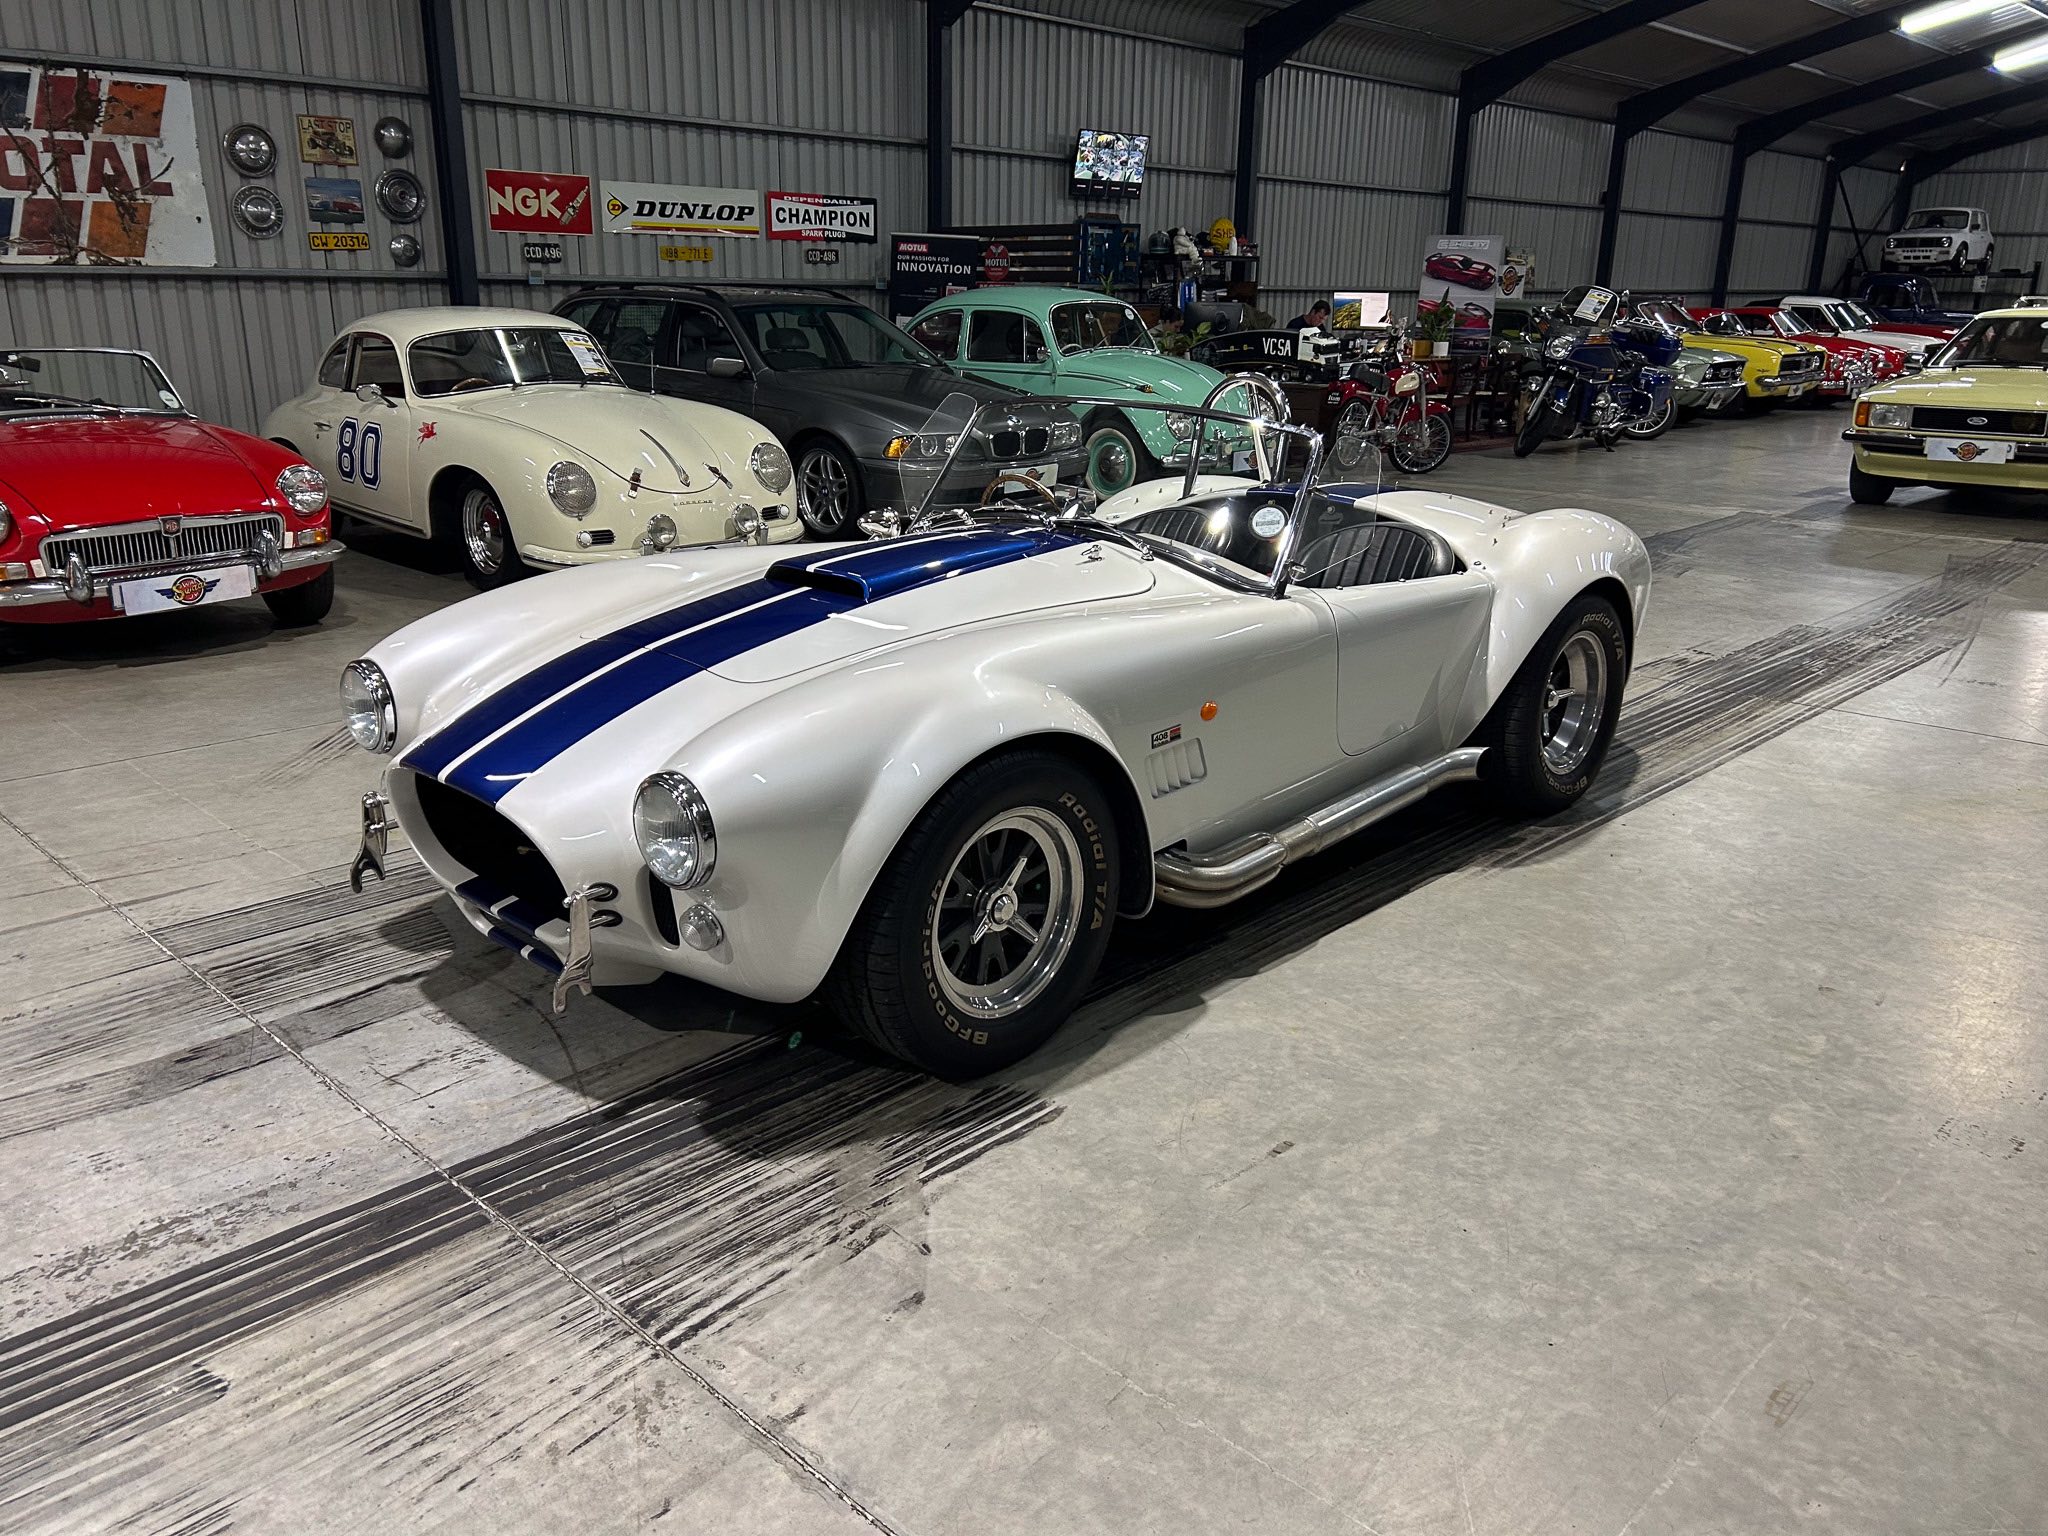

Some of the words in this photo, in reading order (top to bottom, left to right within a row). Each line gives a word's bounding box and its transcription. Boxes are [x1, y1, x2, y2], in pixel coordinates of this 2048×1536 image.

[301, 119, 327, 131] LAST
[327, 121, 352, 134] STOP
[489, 186, 562, 219] NGK
[783, 195, 861, 206] DEPENDABLE
[633, 200, 755, 222] DUNLOP
[775, 206, 871, 228] CHAMPION
[801, 229, 824, 238] SPARK
[824, 230, 846, 239] PLUGS
[311, 235, 332, 248] CW
[333, 235, 368, 248] 20314
[898, 243, 928, 252] MOTUL
[524, 246, 542, 259] CCD
[544, 247, 562, 259] 496
[896, 261, 971, 274] INNOVATION
[985, 258, 1008, 267] MOTUL
[1262, 337, 1292, 357] VCSA
[336, 416, 382, 491] 80
[165, 521, 178, 534] MG
[1581, 612, 1614, 629] Radial
[1154, 732, 1168, 742] 408
[1058, 791, 1106, 869] Radial
[1090, 881, 1109, 930] T/A
